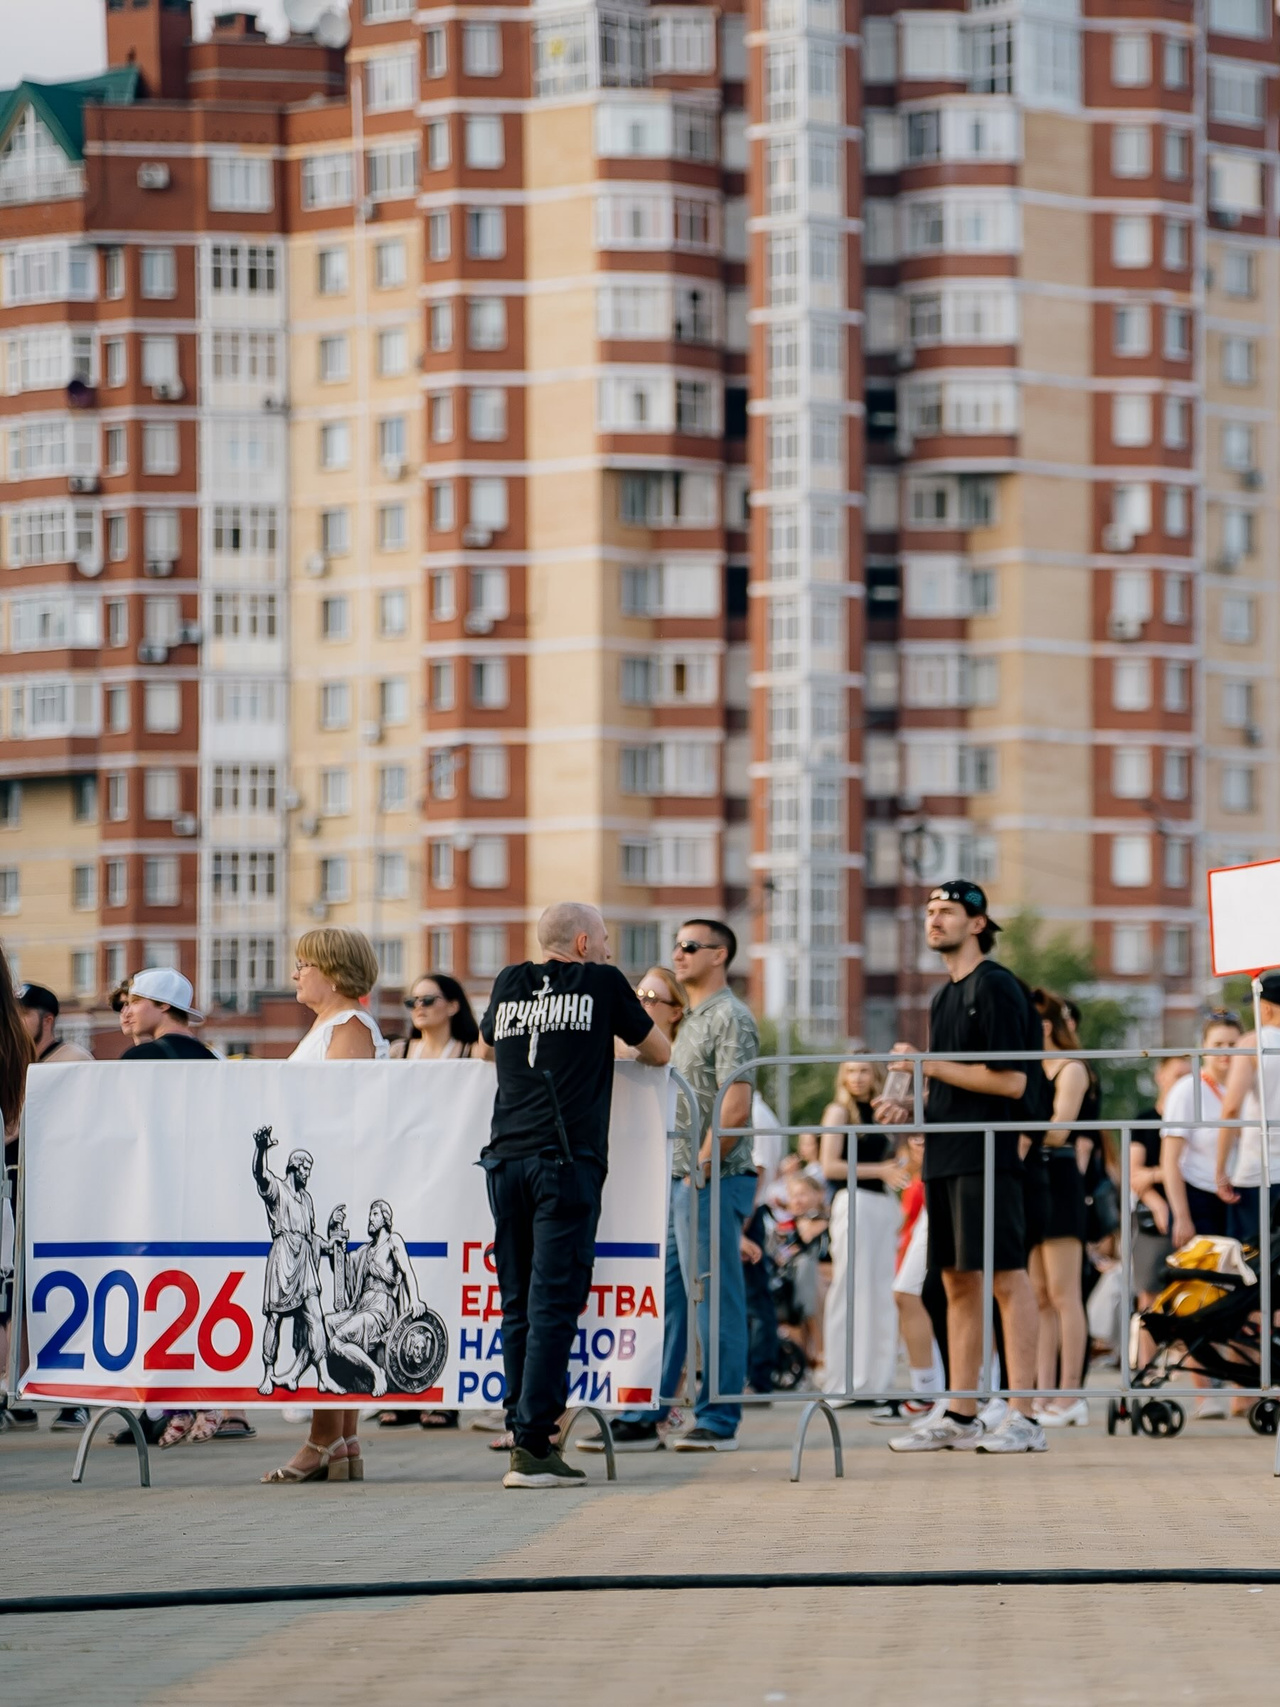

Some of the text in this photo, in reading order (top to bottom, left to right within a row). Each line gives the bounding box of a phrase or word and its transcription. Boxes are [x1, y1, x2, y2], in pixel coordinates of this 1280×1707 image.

[494, 993, 593, 1041] ДРУЖИНА
[463, 1242, 499, 1273] ГО
[32, 1269, 254, 1371] 2026
[461, 1285, 659, 1323] ЕДТВА
[459, 1328, 637, 1366] НАДОВ
[457, 1371, 612, 1403] РОИИ
